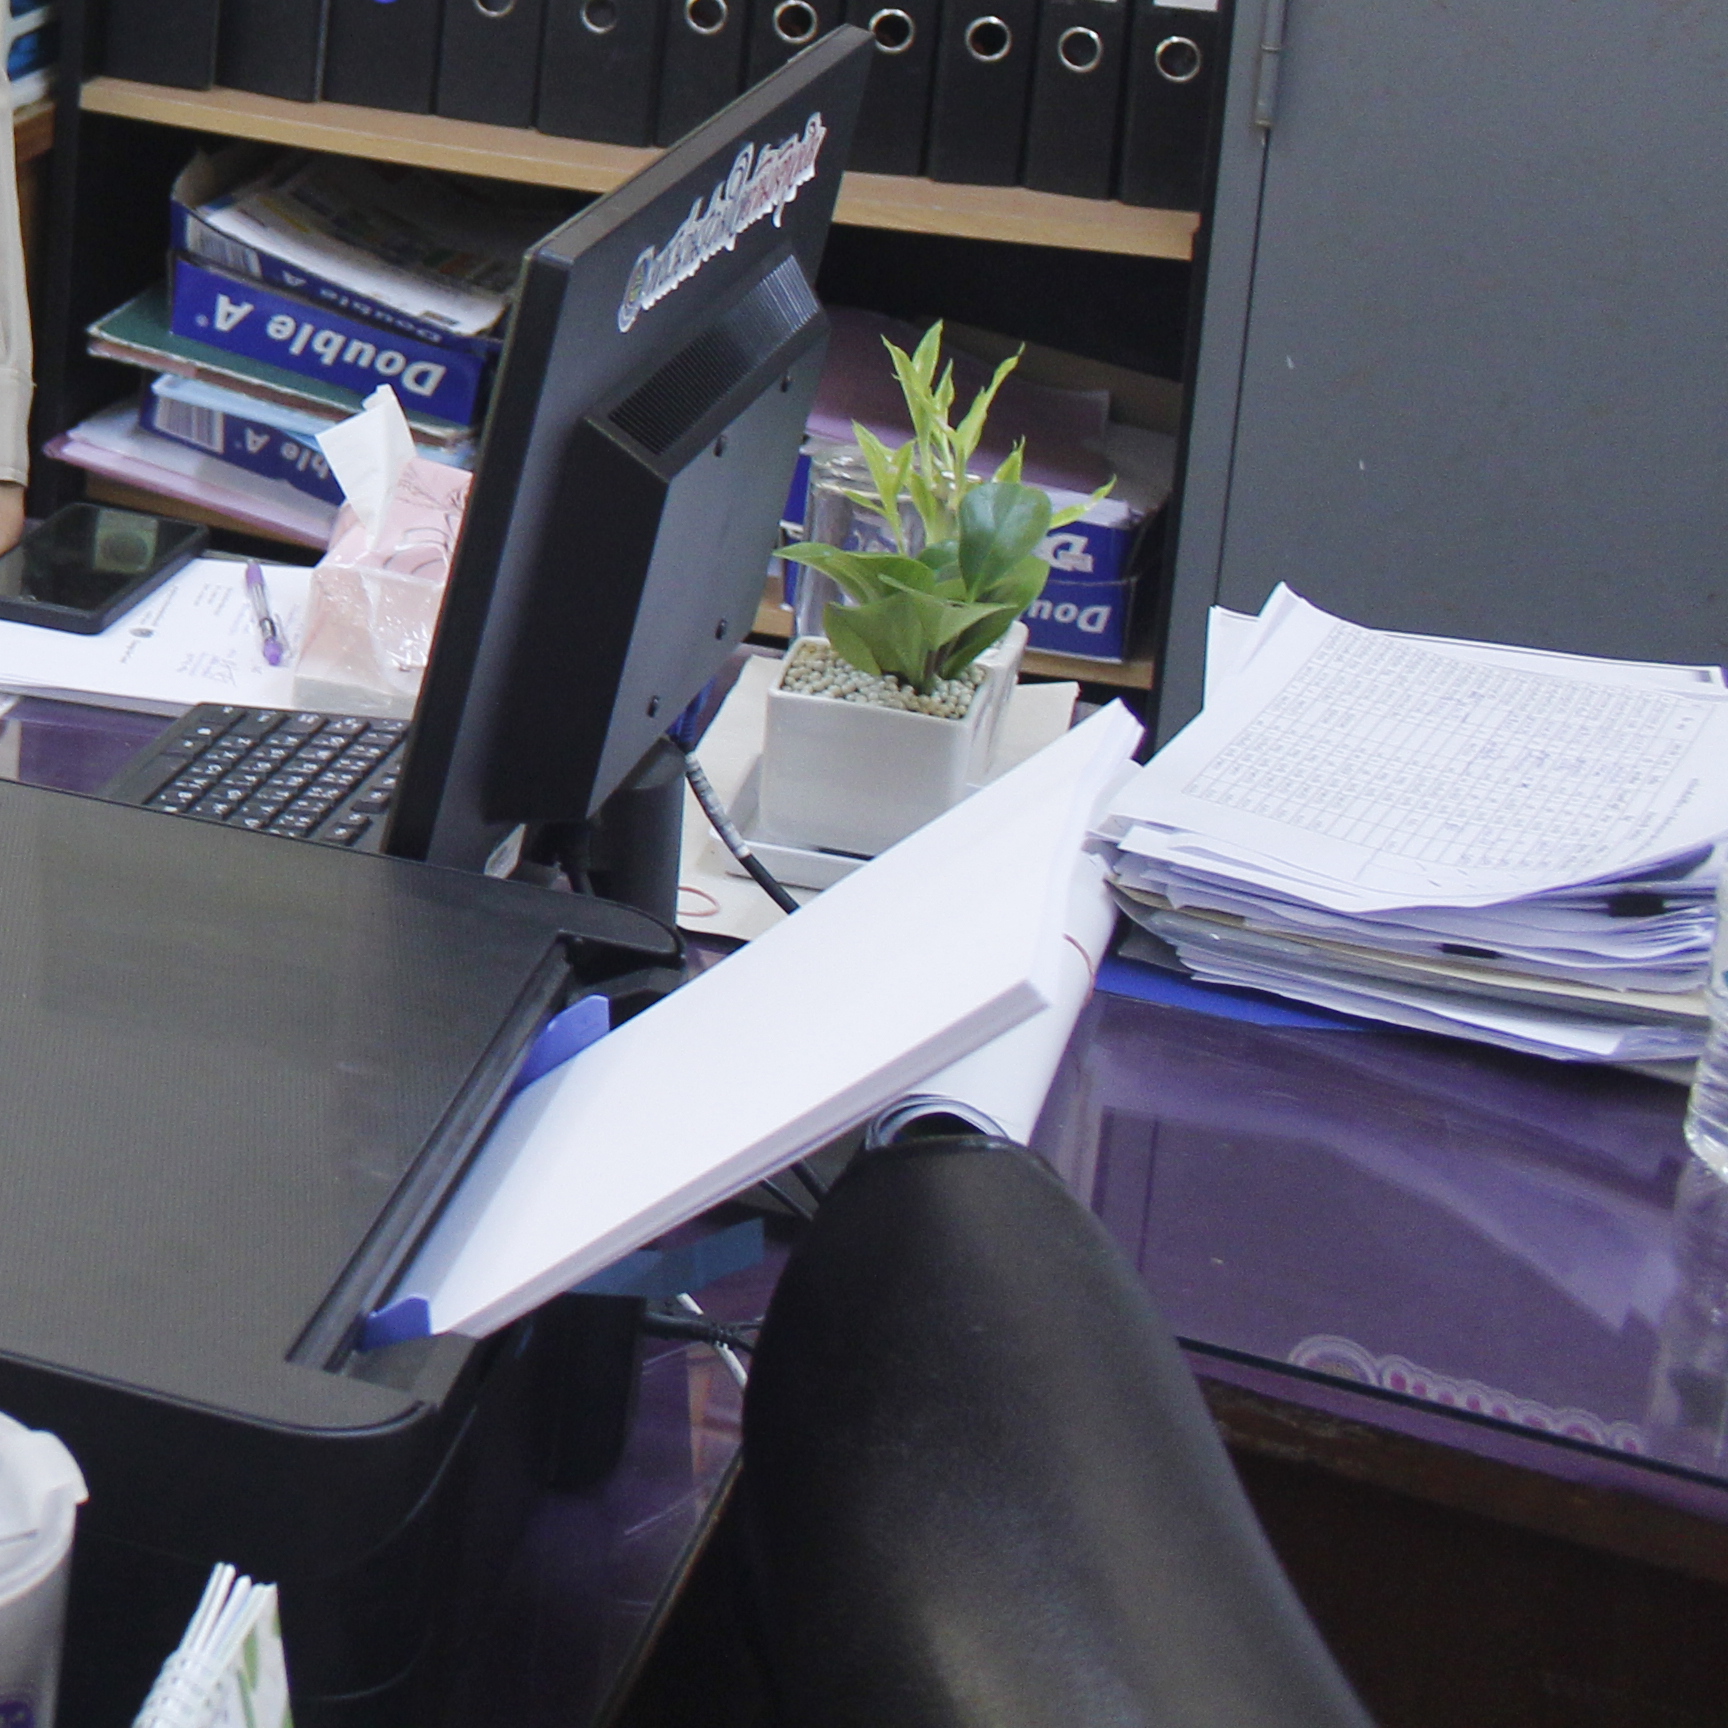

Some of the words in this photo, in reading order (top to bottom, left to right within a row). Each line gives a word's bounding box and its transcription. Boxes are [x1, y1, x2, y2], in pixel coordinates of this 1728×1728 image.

[213, 293, 255, 332] A
[265, 314, 447, 397] Double
[243, 428, 271, 454] A
[1028, 598, 1112, 635] Dou
